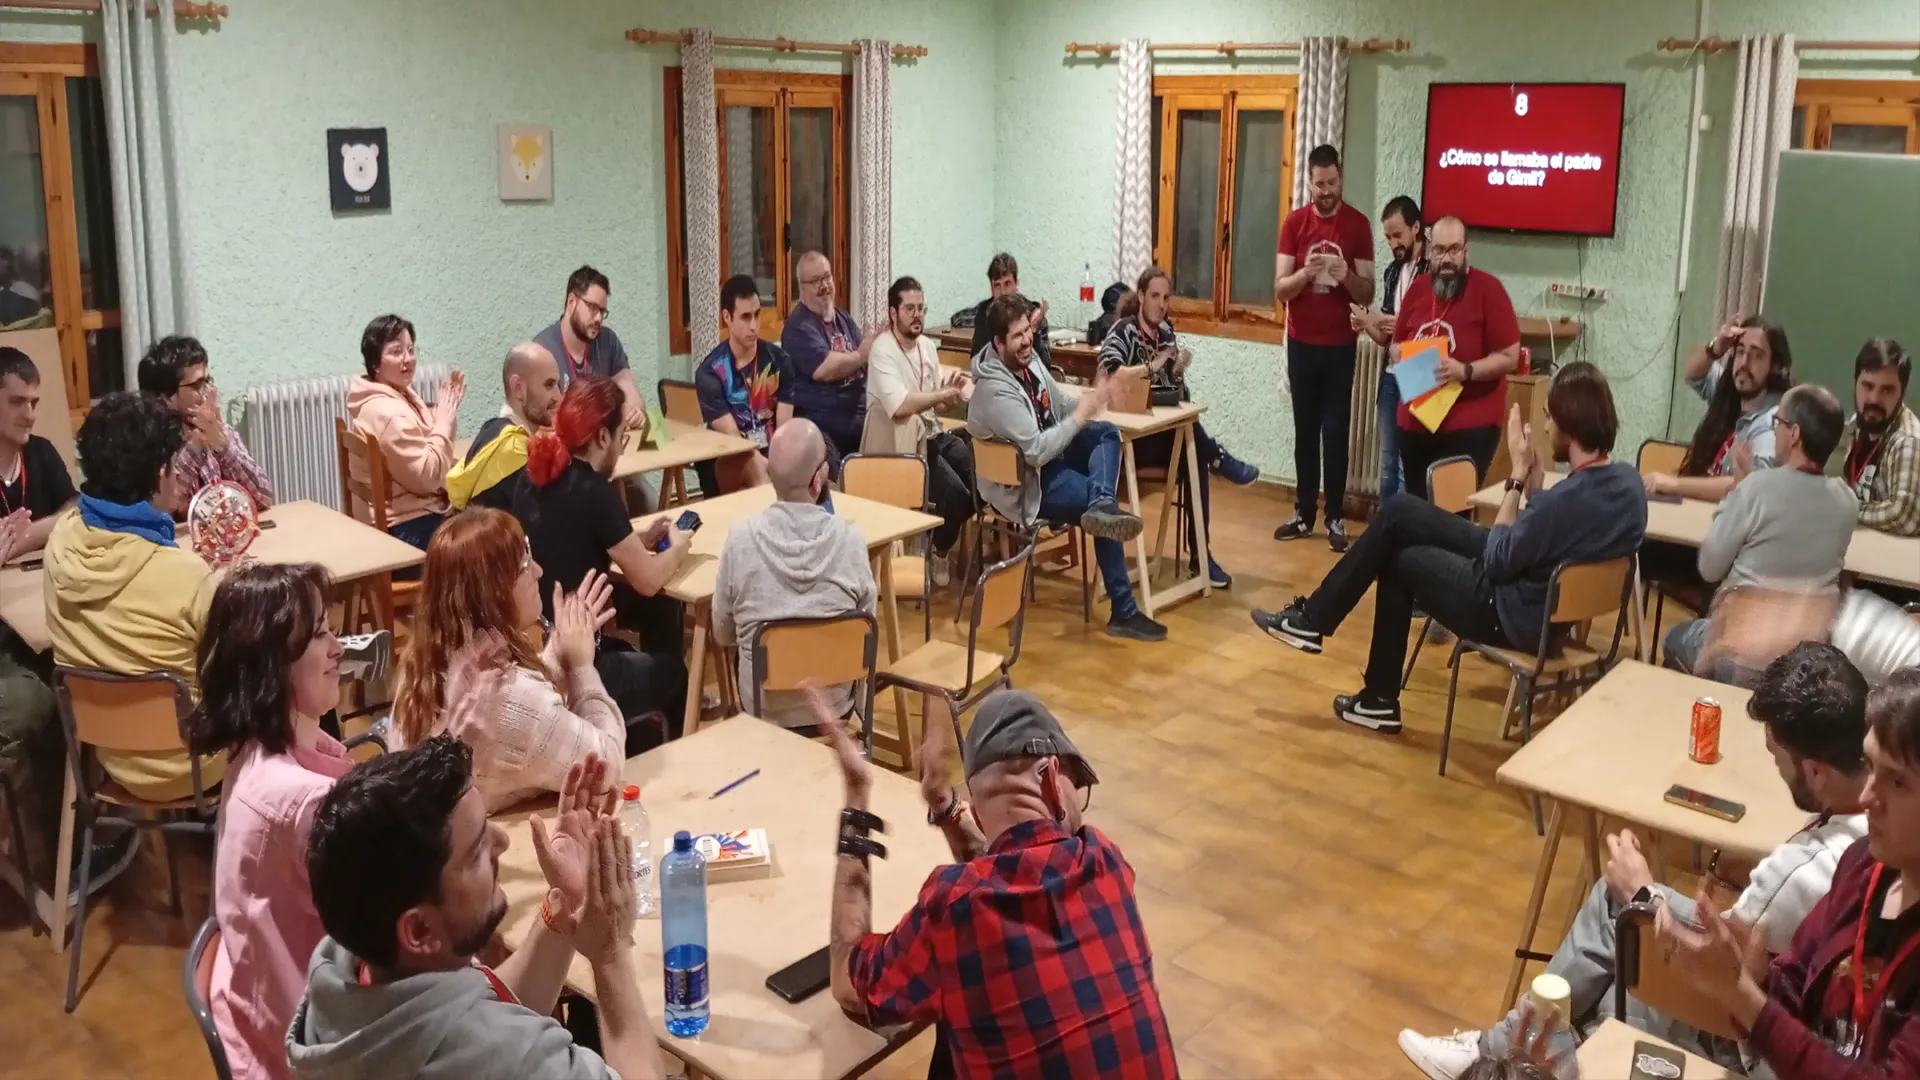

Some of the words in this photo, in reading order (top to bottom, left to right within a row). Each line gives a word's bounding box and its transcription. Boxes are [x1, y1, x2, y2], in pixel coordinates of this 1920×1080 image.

[1515, 93, 1528, 116] 8
[1439, 148, 1482, 168] ¿Cómo
[1484, 152, 1499, 167] se
[1501, 150, 1549, 169] llamaba
[1550, 152, 1563, 168] el
[1564, 153, 1602, 172] padre
[1488, 169, 1505, 186] de
[1506, 168, 1546, 187] Gimli?
